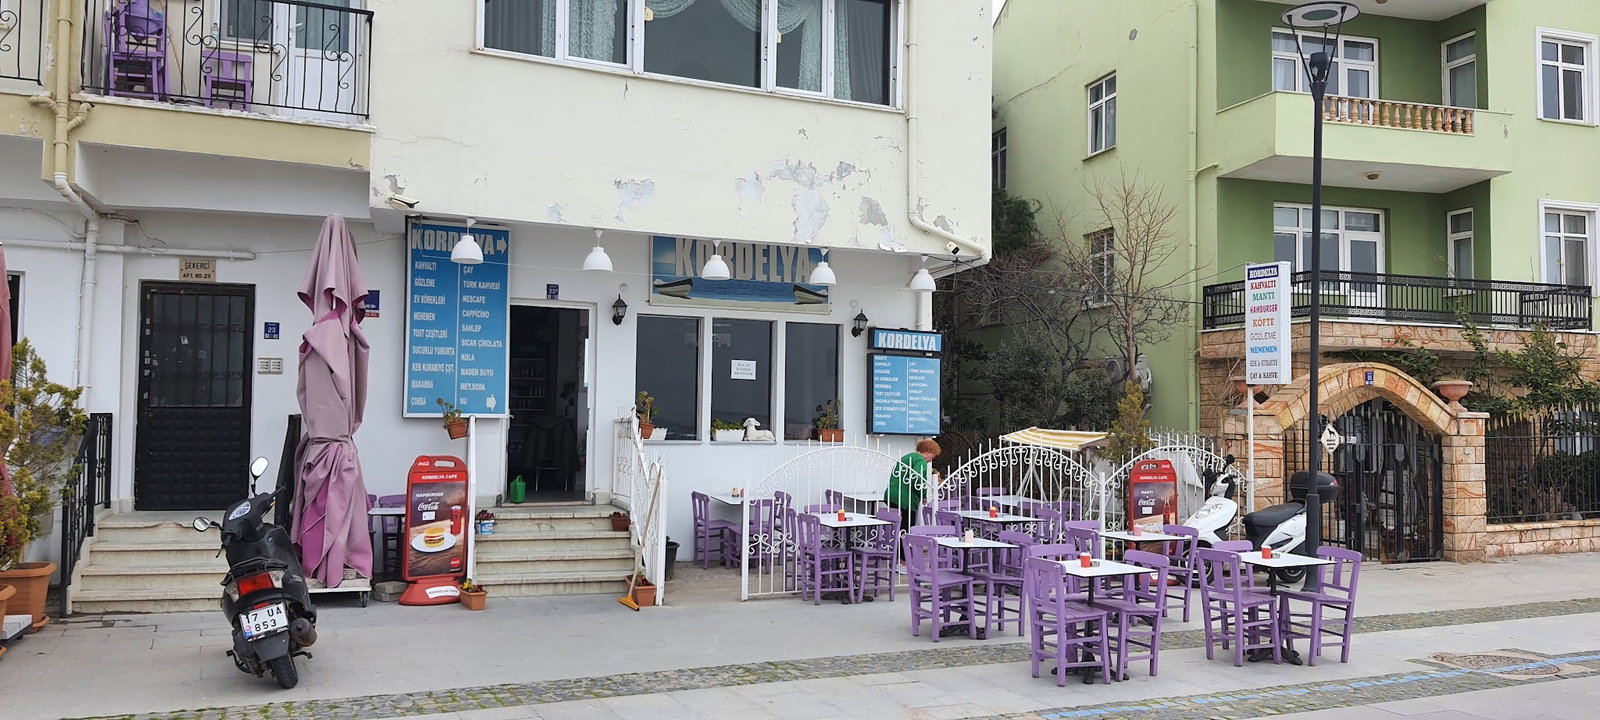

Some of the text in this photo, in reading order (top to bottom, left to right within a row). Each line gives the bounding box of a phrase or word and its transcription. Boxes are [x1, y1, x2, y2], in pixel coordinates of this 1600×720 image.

[184, 261, 210, 270] ŞEKERCİ
[415, 261, 437, 270] KAHVALTI
[463, 266, 473, 275] ÇAY
[414, 276, 436, 287] GÖZLEME
[463, 279, 501, 290] TÜRK KAHVESİ
[1250, 280, 1277, 290] KAHVALTI
[414, 294, 446, 304] EV BÖREKLERİ
[462, 295, 485, 304] NESCAFE
[1252, 291, 1275, 301] MANTI
[1250, 304, 1278, 313] HAMBURGER
[414, 312, 435, 320] MENEMEN
[1252, 317, 1275, 328] KÖFTE
[462, 324, 481, 332] SAHLEP
[413, 328, 448, 340] TOST ÇEŞİTLERİ
[1250, 331, 1277, 341] GÖZLEME
[461, 339, 502, 349] SICAK ÇİKOLATA
[878, 332, 936, 351] KORDELYA
[412, 346, 434, 355] SUCUKLU
[1249, 346, 1278, 354] MENEMEN
[412, 363, 422, 371] KEK
[422, 363, 444, 372] KURABİYE
[461, 368, 494, 377] MADEN SUYU
[1263, 371, 1278, 379] KAHVE
[411, 380, 433, 389] MAKARNA
[411, 397, 426, 406] ÇORBA
[246, 606, 282, 624] 17 UA
[254, 618, 277, 632] 853
